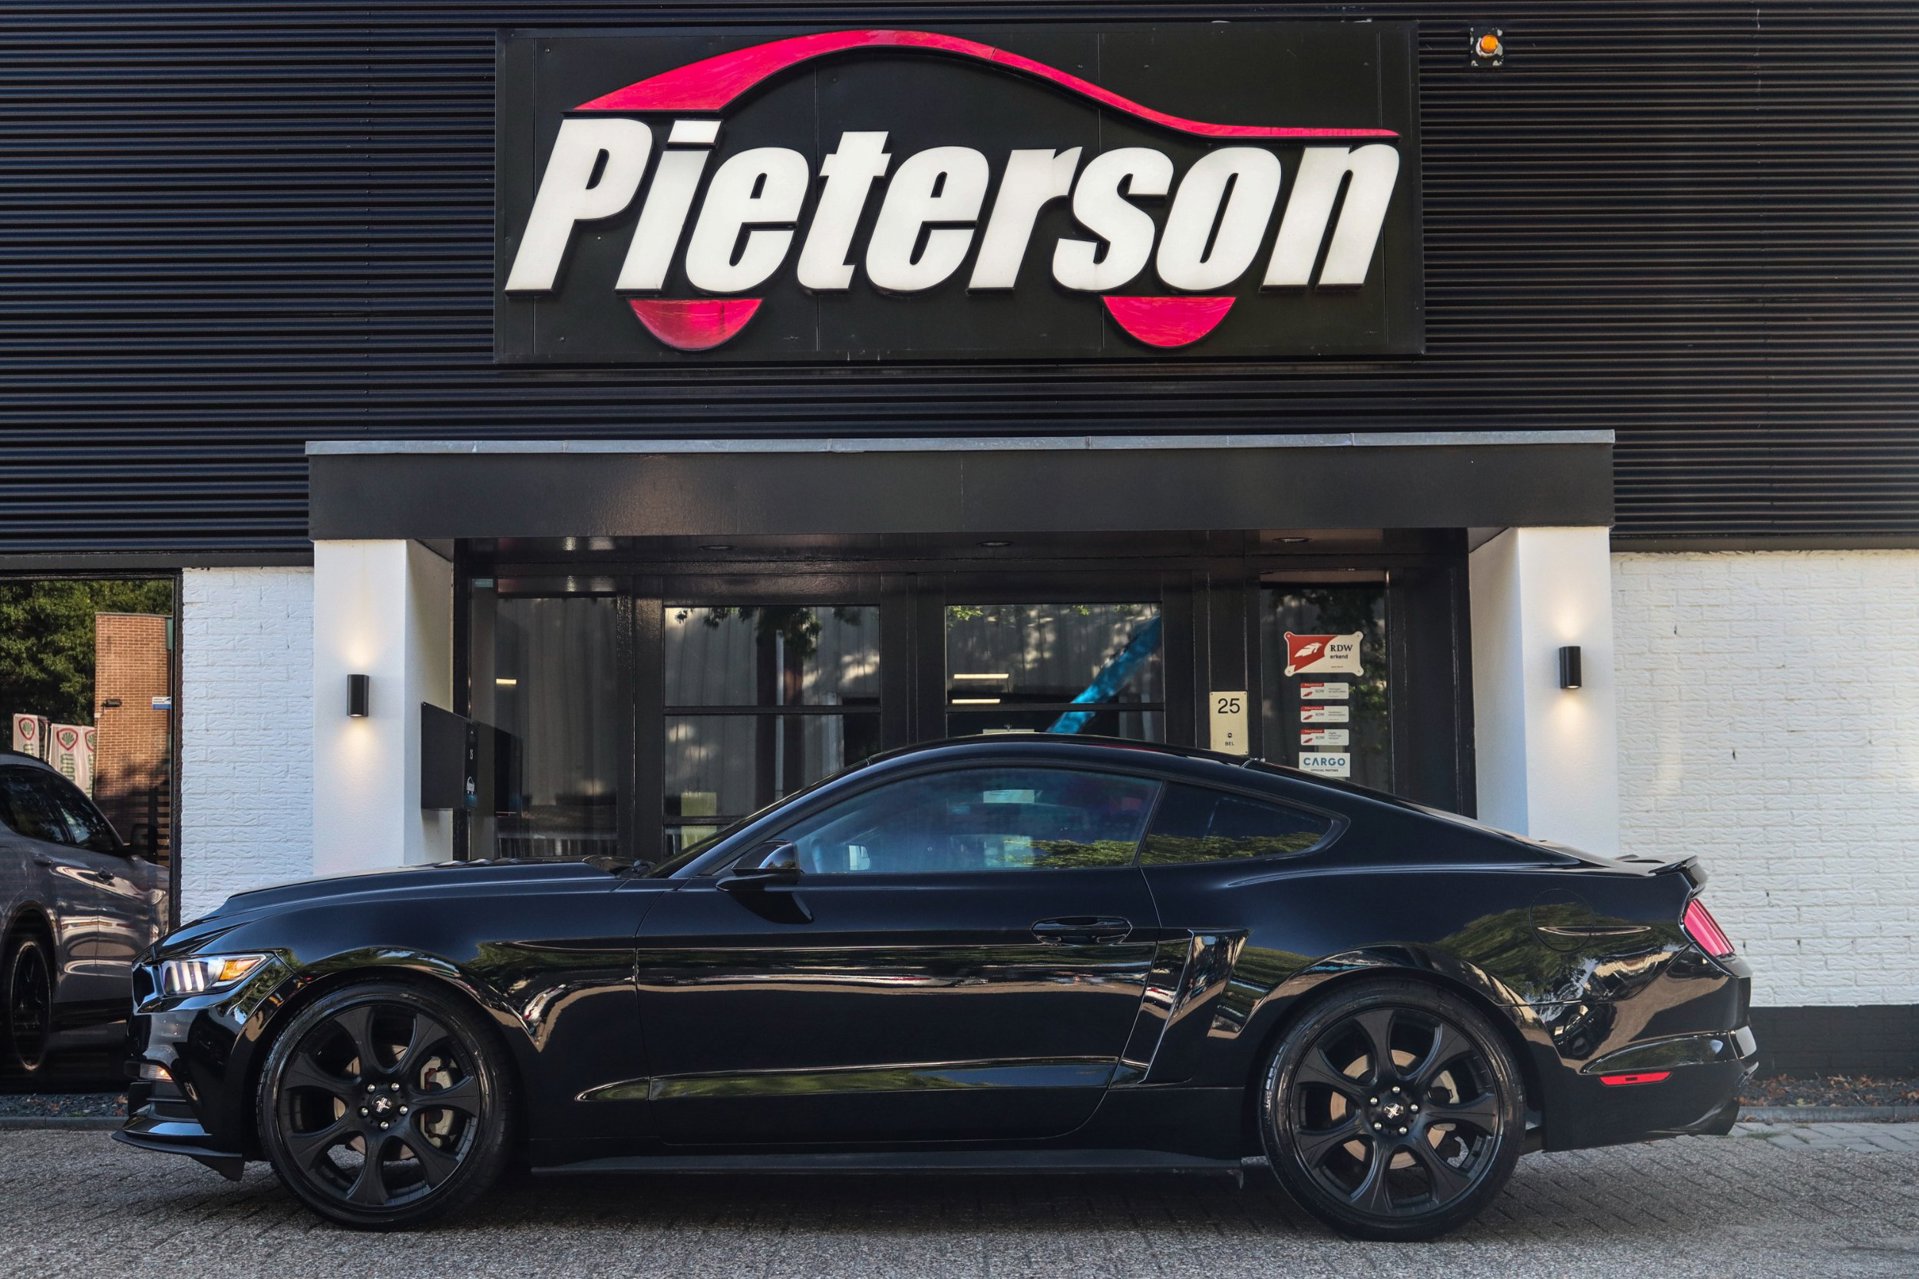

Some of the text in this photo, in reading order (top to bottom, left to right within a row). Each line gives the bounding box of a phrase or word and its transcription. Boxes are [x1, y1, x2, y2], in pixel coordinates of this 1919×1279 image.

[504, 118, 1400, 293] Pieterson
[1330, 644, 1353, 652] RDW
[1217, 697, 1241, 714] 25
[1303, 757, 1346, 766] CARGO
